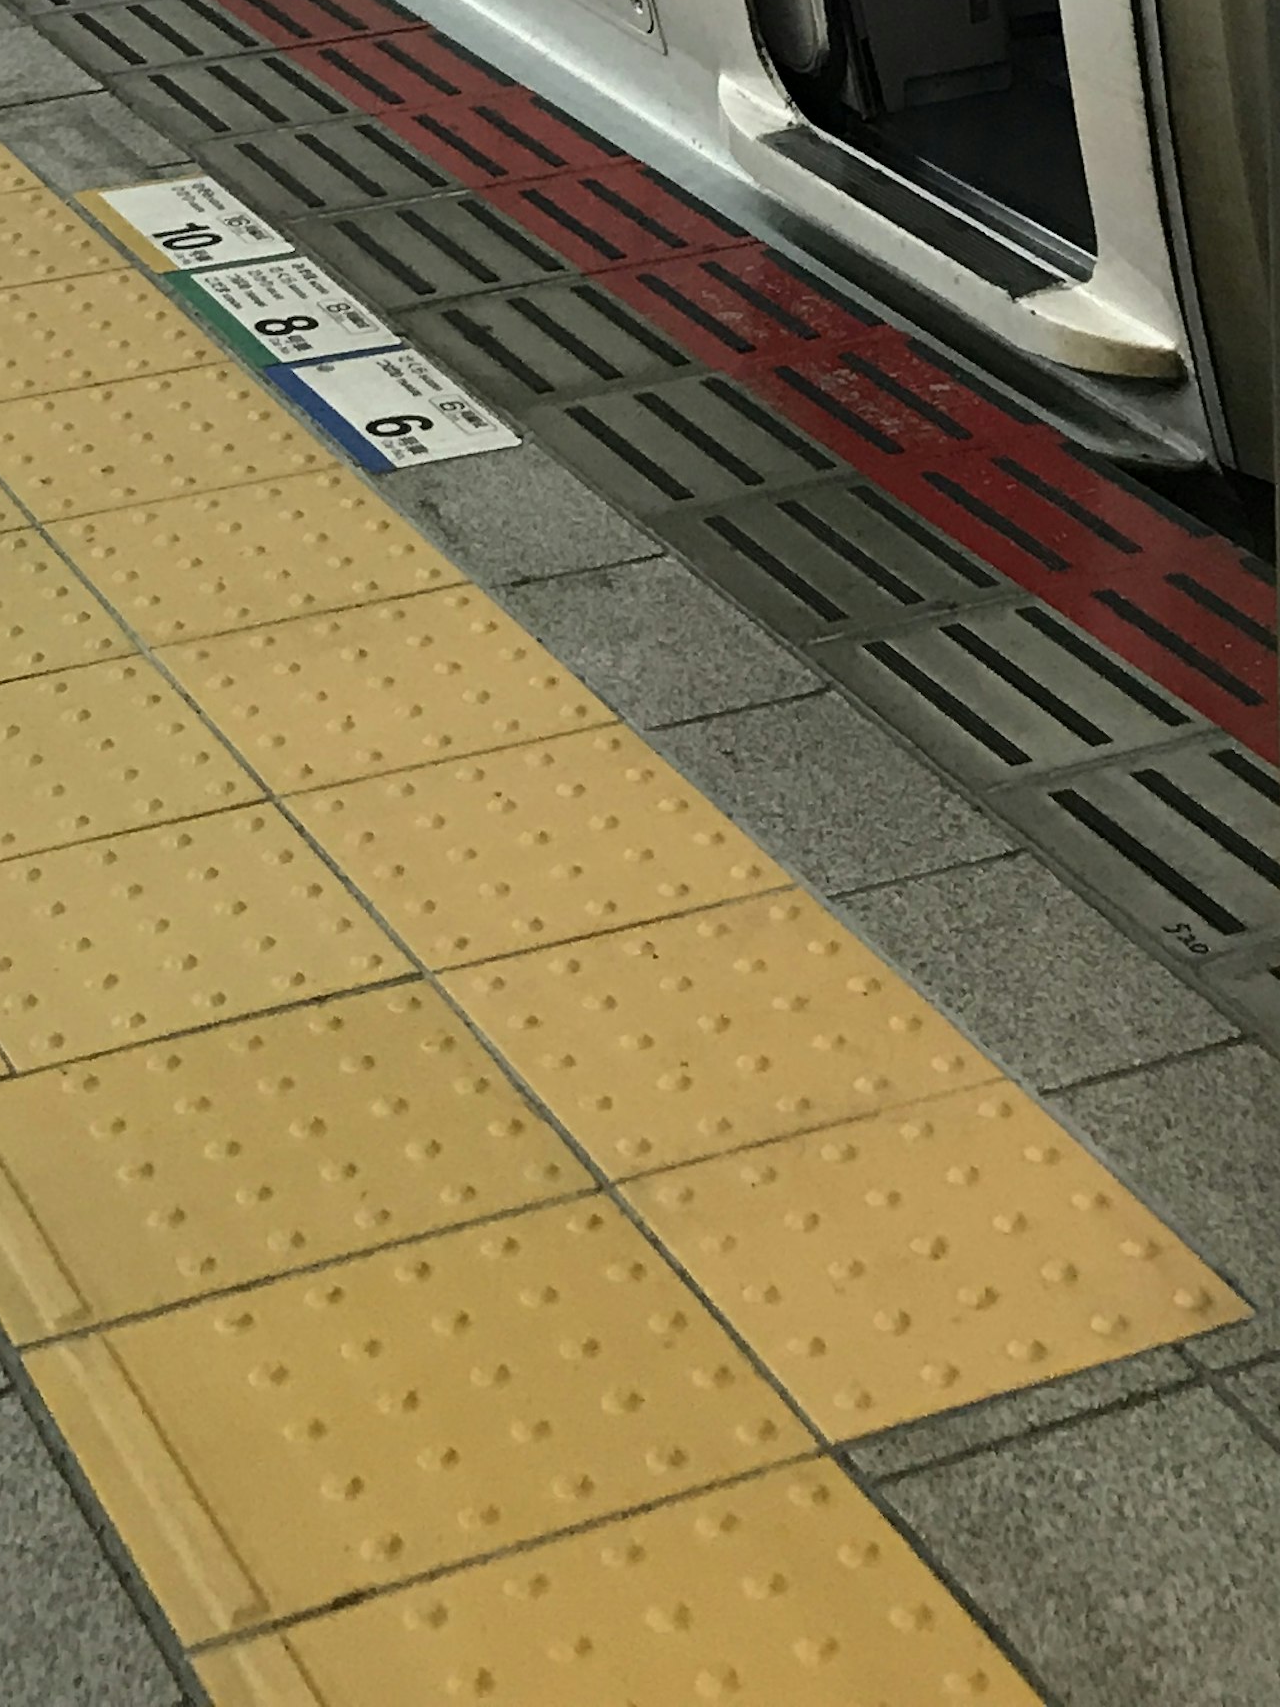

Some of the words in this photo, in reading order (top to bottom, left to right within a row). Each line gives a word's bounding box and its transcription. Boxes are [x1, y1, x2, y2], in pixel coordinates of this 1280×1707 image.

[152, 222, 223, 251] 10
[255, 315, 320, 337] 8
[365, 415, 435, 437] 6
